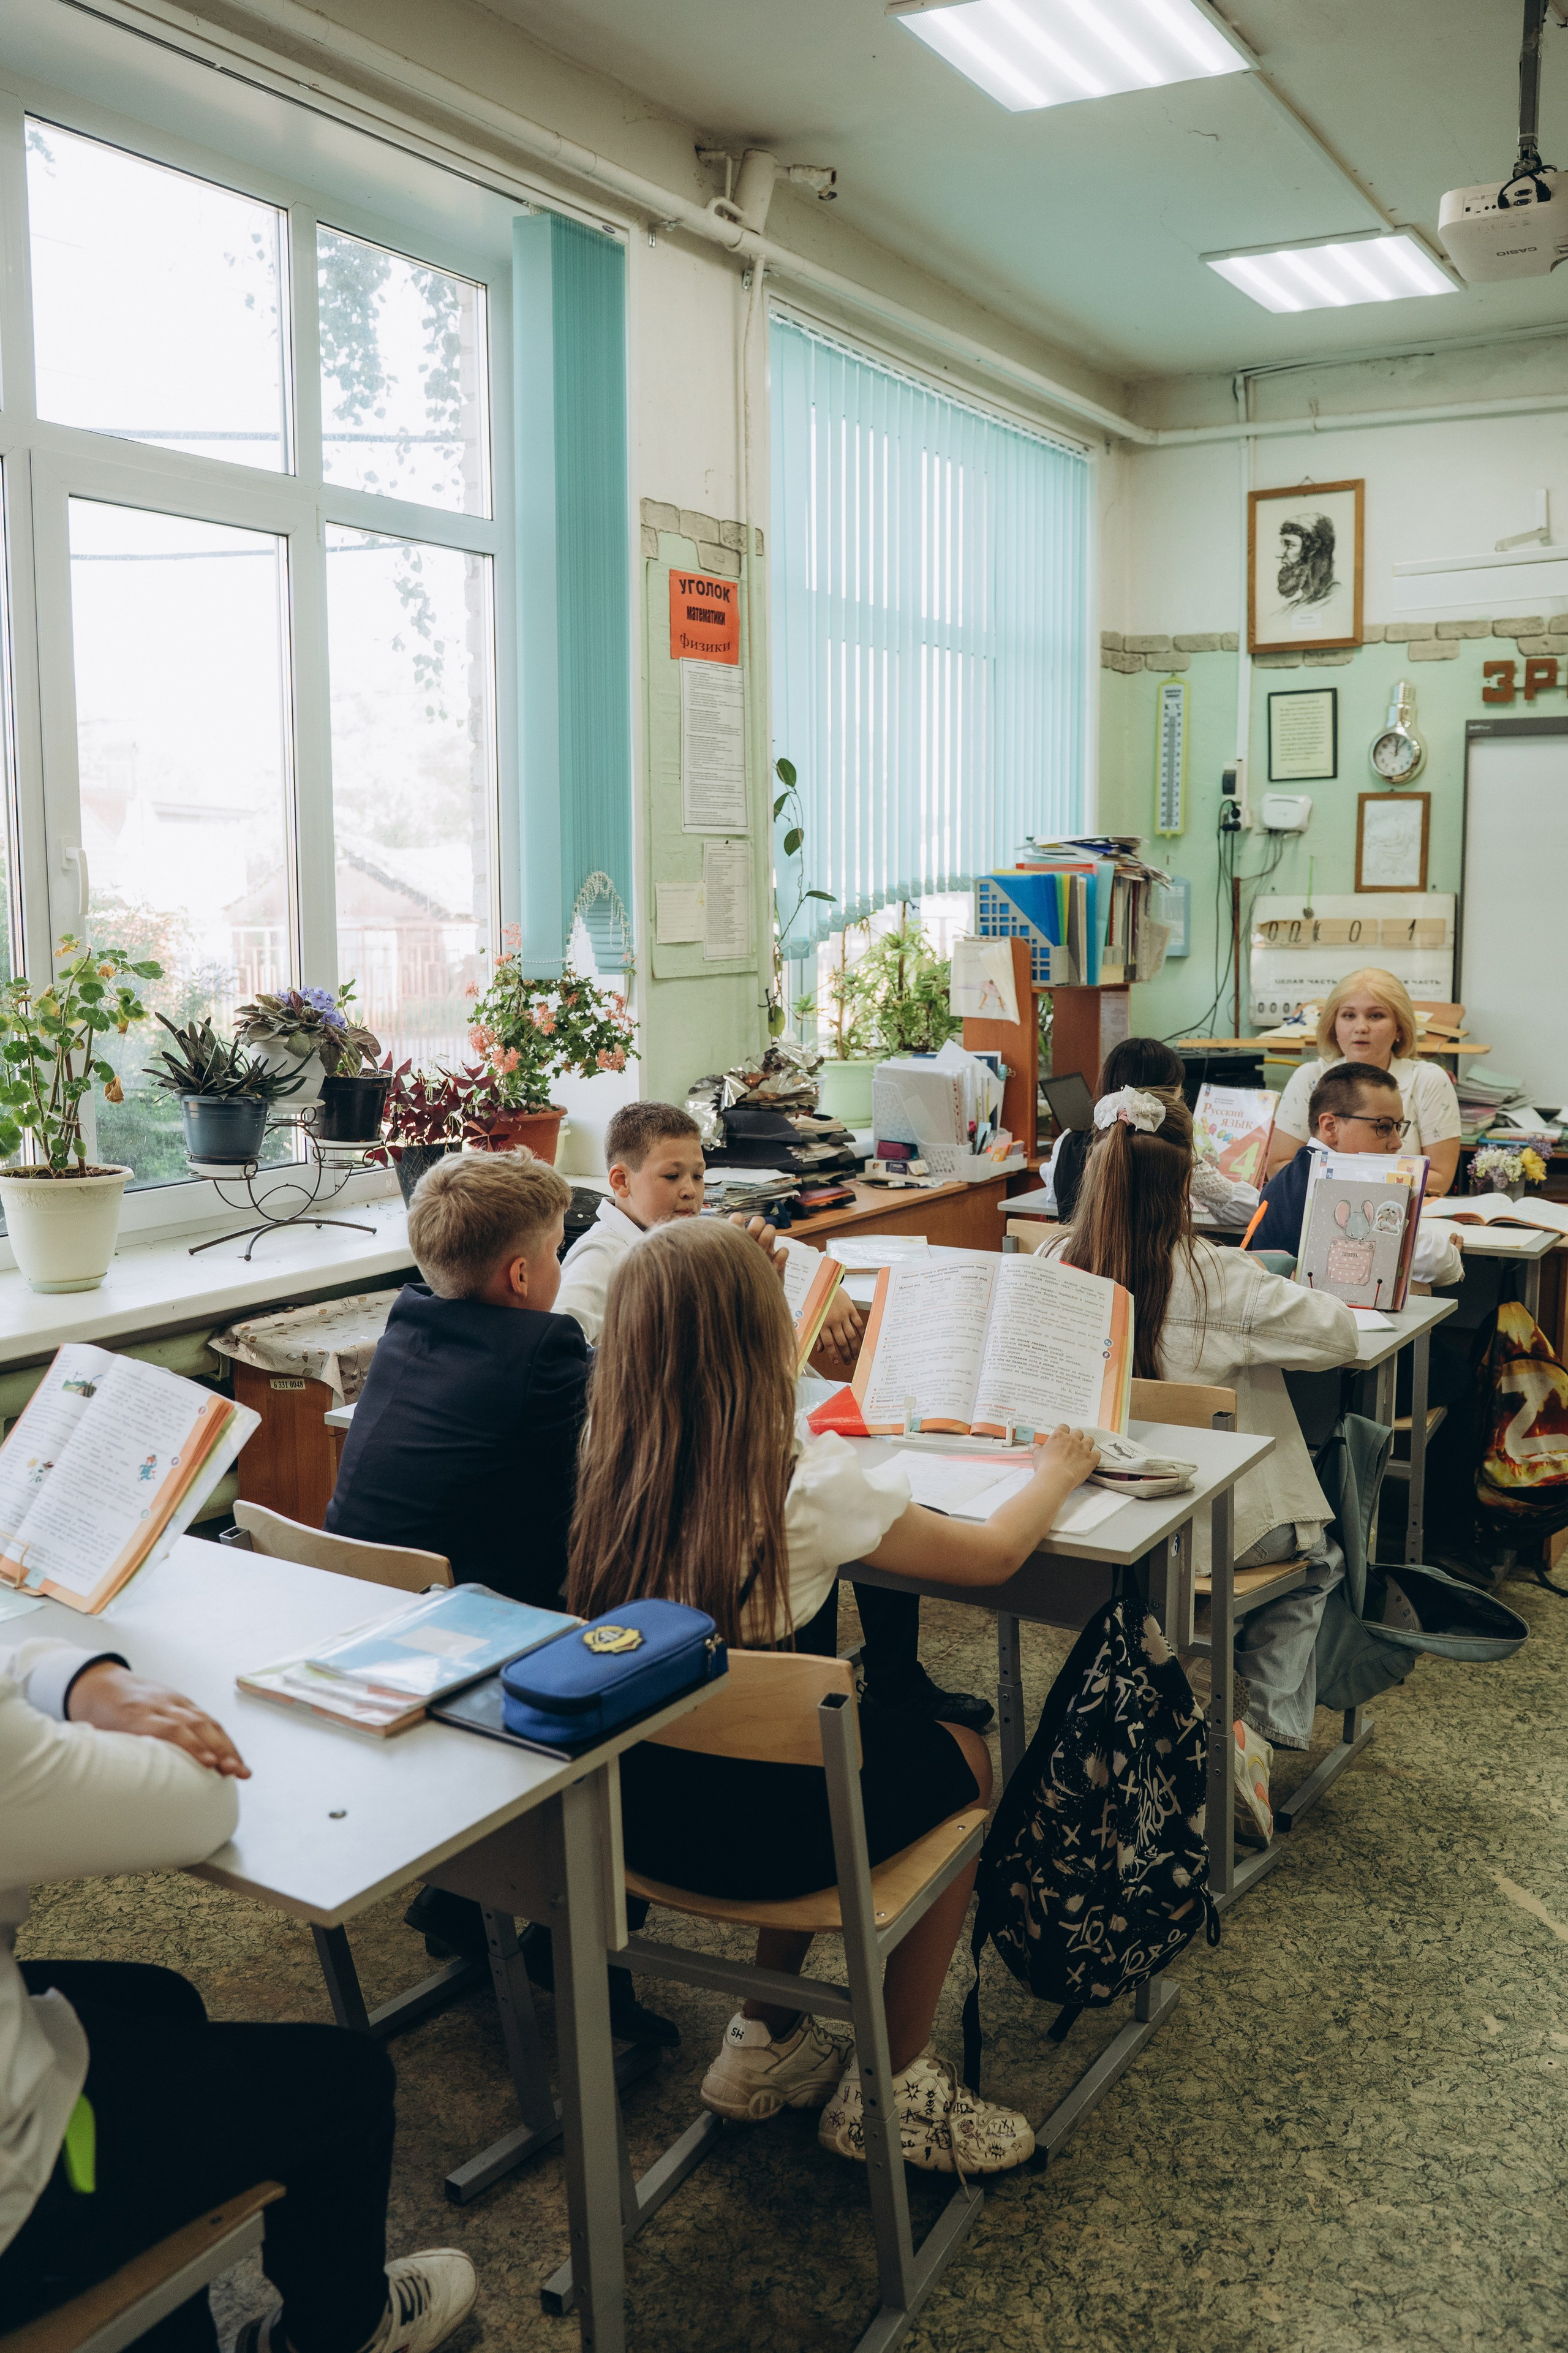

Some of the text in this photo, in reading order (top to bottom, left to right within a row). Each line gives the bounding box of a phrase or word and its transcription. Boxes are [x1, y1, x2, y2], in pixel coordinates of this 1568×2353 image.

[1496, 247, 1537, 256] CASIO
[679, 579, 730, 603] УГОЛОК
[687, 606, 725, 625] математики
[680, 633, 731, 652] физики
[1202, 1103, 1244, 1117] Русский
[1229, 1141, 1261, 1182] 4
